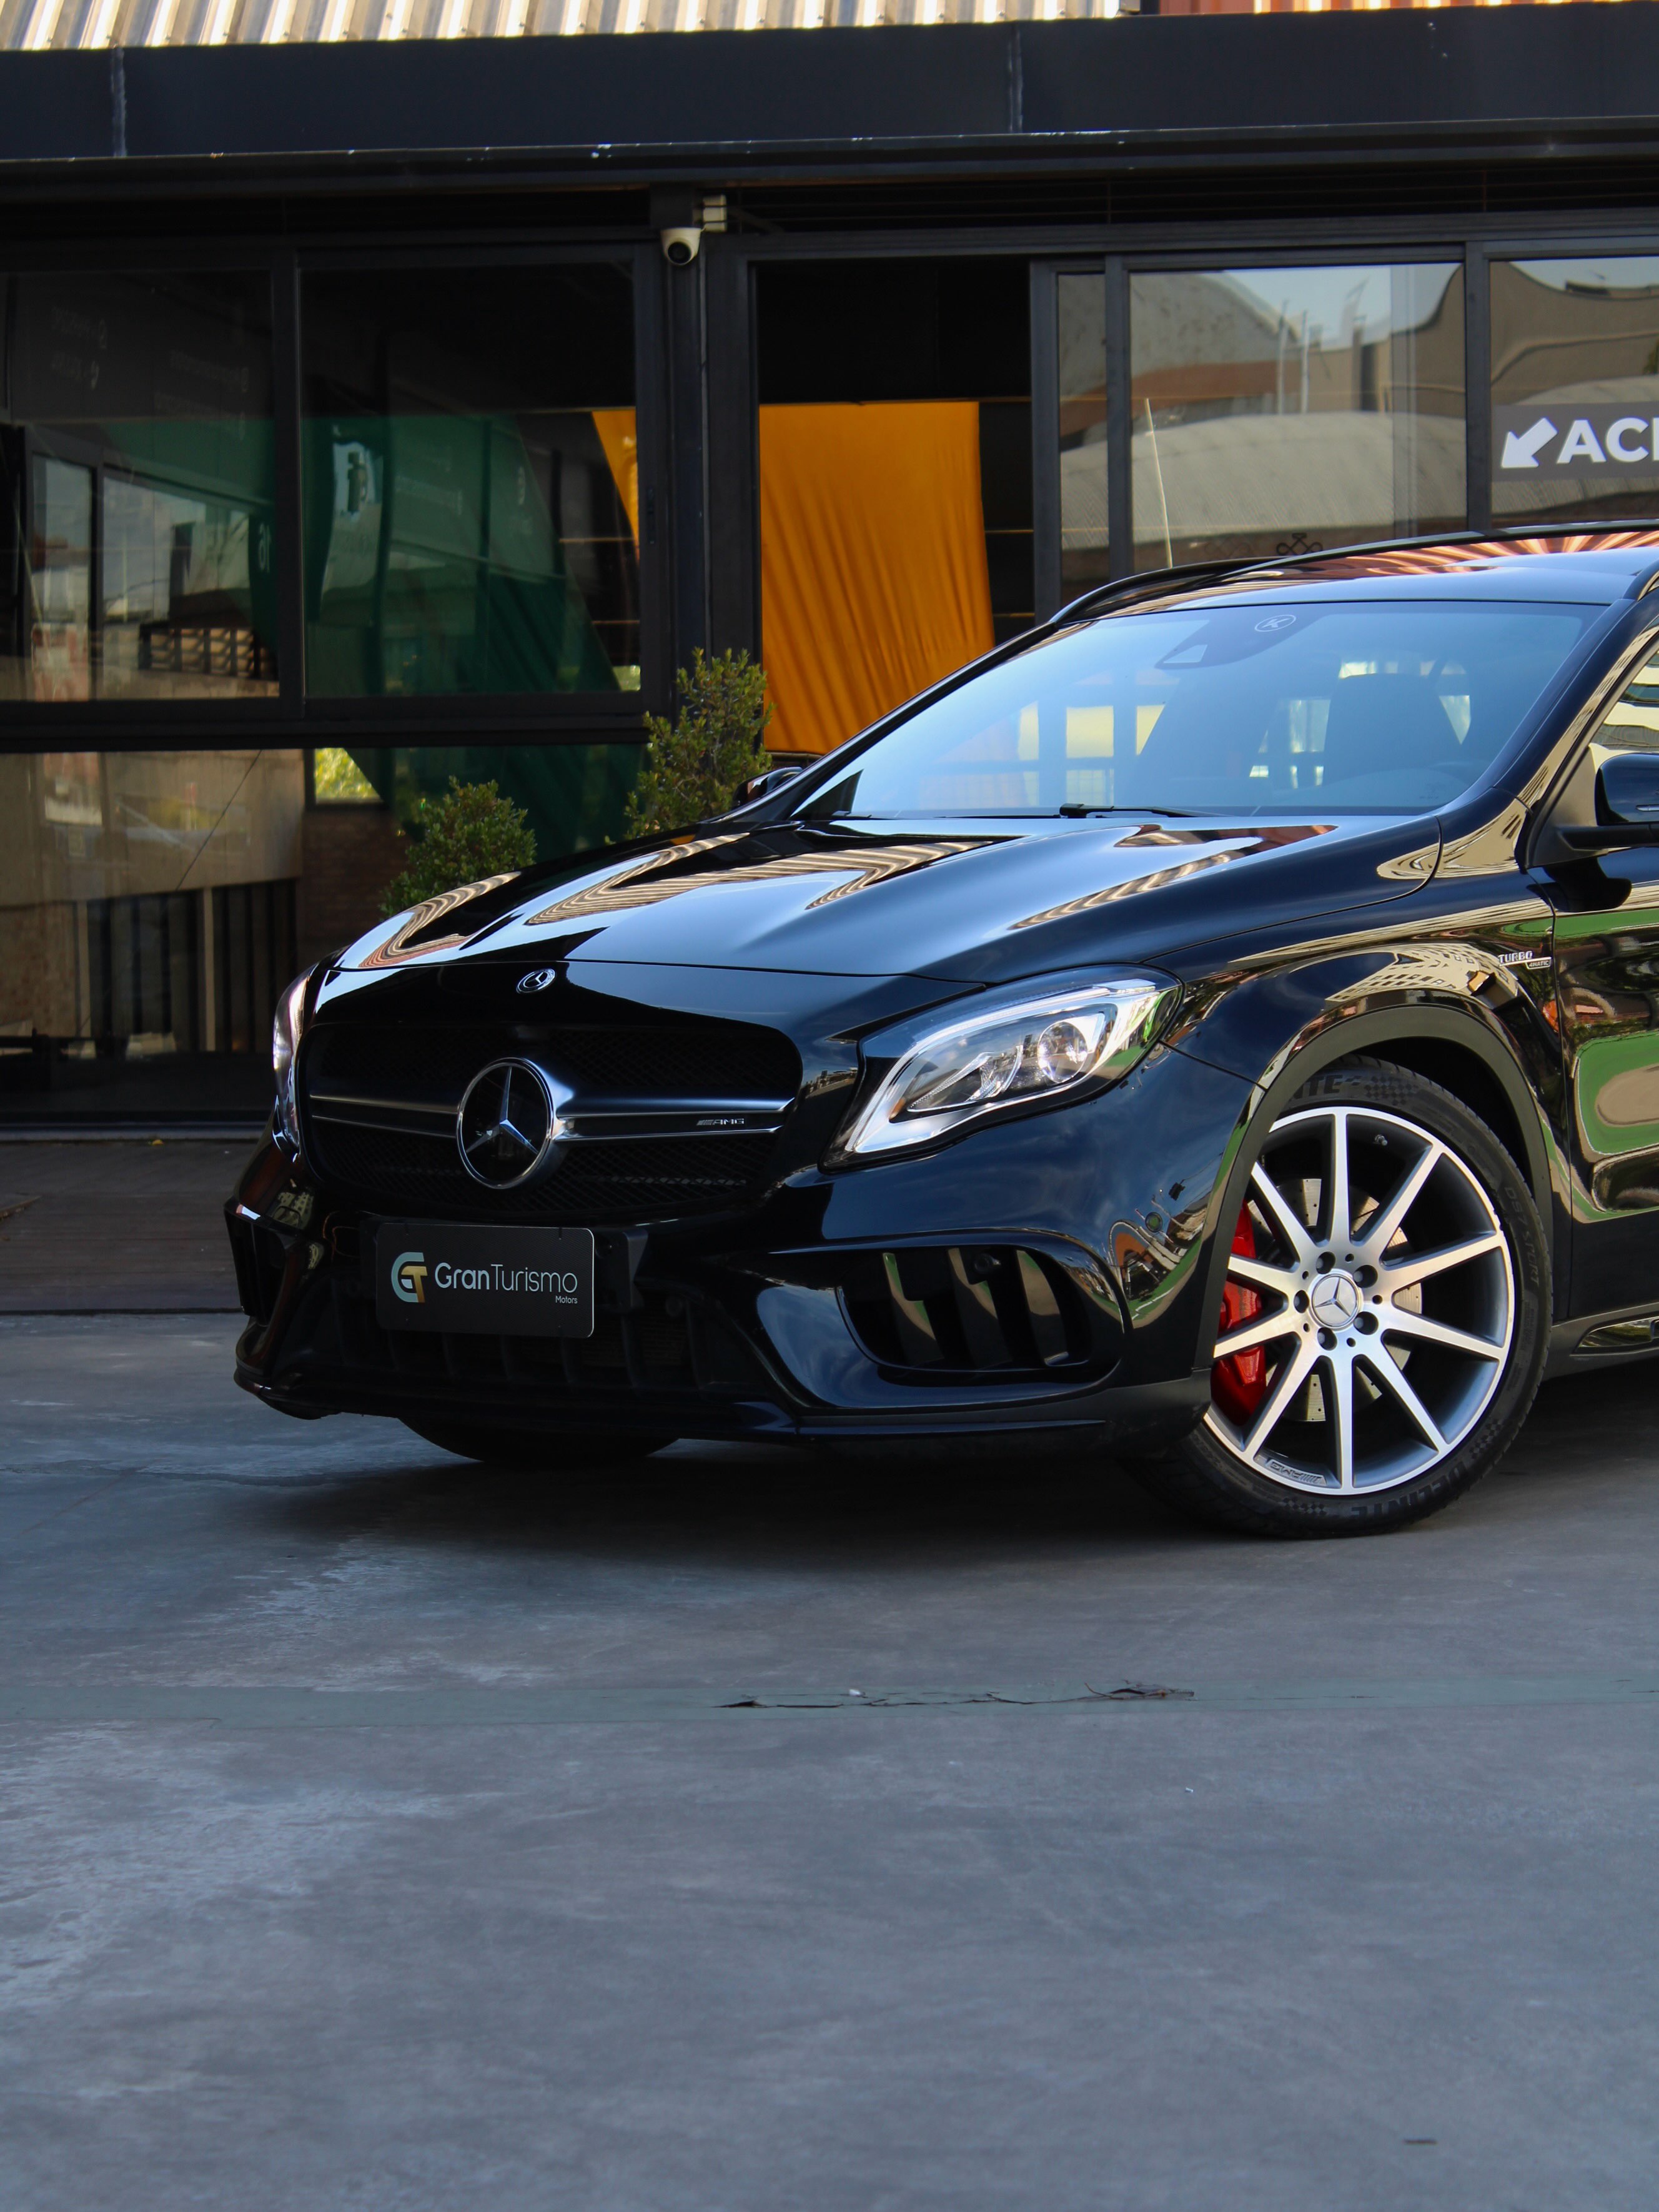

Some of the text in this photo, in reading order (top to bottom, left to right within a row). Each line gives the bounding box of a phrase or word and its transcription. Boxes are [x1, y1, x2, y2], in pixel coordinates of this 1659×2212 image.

[1557, 417, 1659, 464] AC
[1498, 951, 1533, 963] TURBO
[1522, 1230, 1540, 1289] SPORT
[555, 1295, 578, 1304] Motors
[1269, 1461, 1304, 1479] AMG
